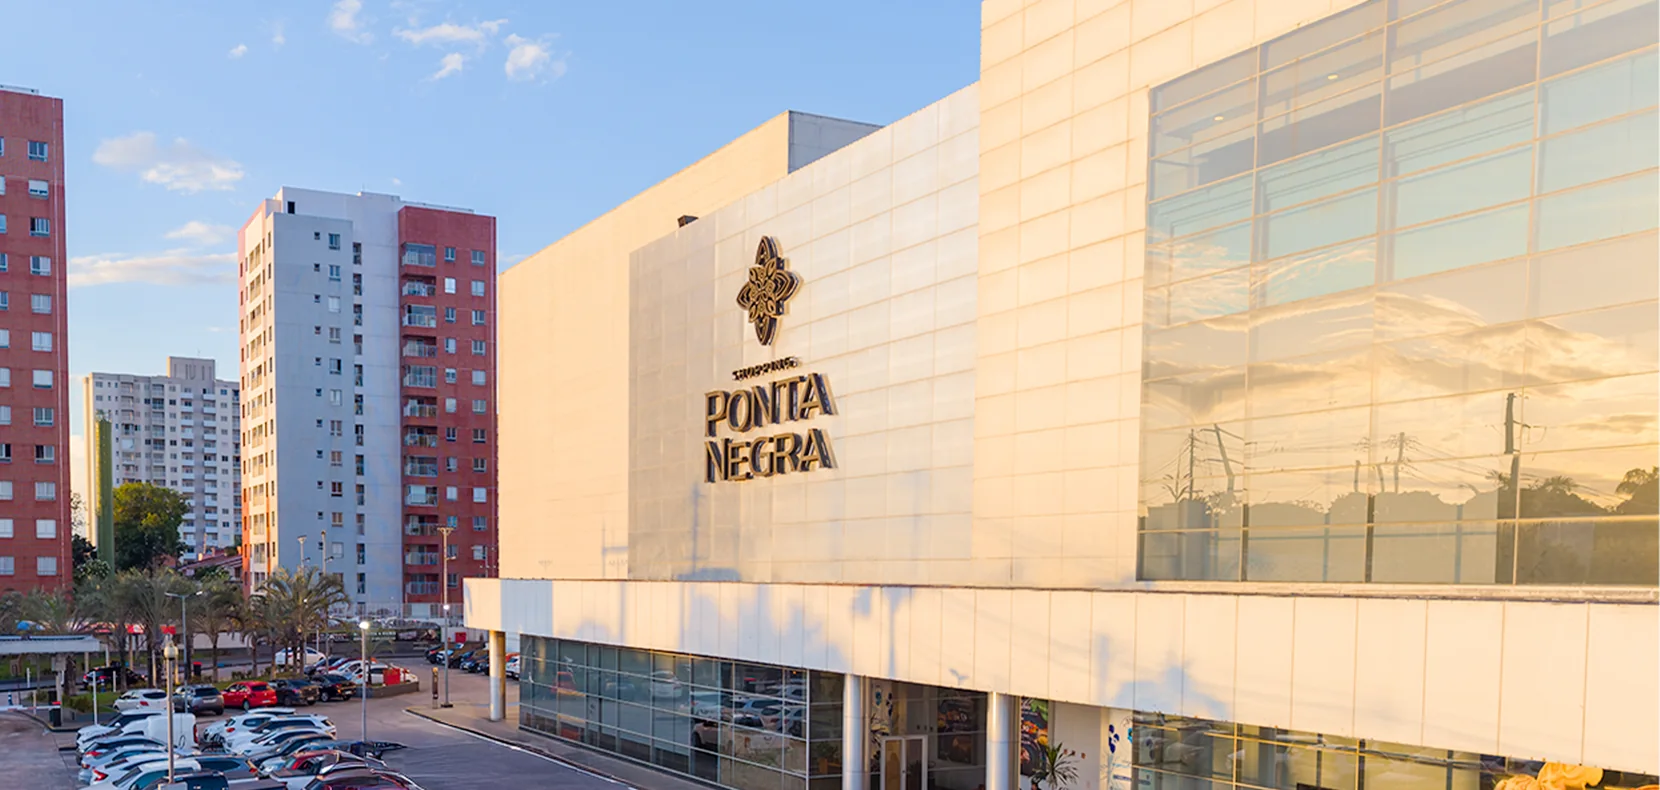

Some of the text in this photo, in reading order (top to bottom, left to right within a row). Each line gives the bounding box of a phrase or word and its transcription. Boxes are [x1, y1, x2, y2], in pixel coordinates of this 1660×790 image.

[732, 356, 798, 380] SHOPPING
[704, 373, 834, 437] PONTA
[704, 429, 834, 483] NEGRA
